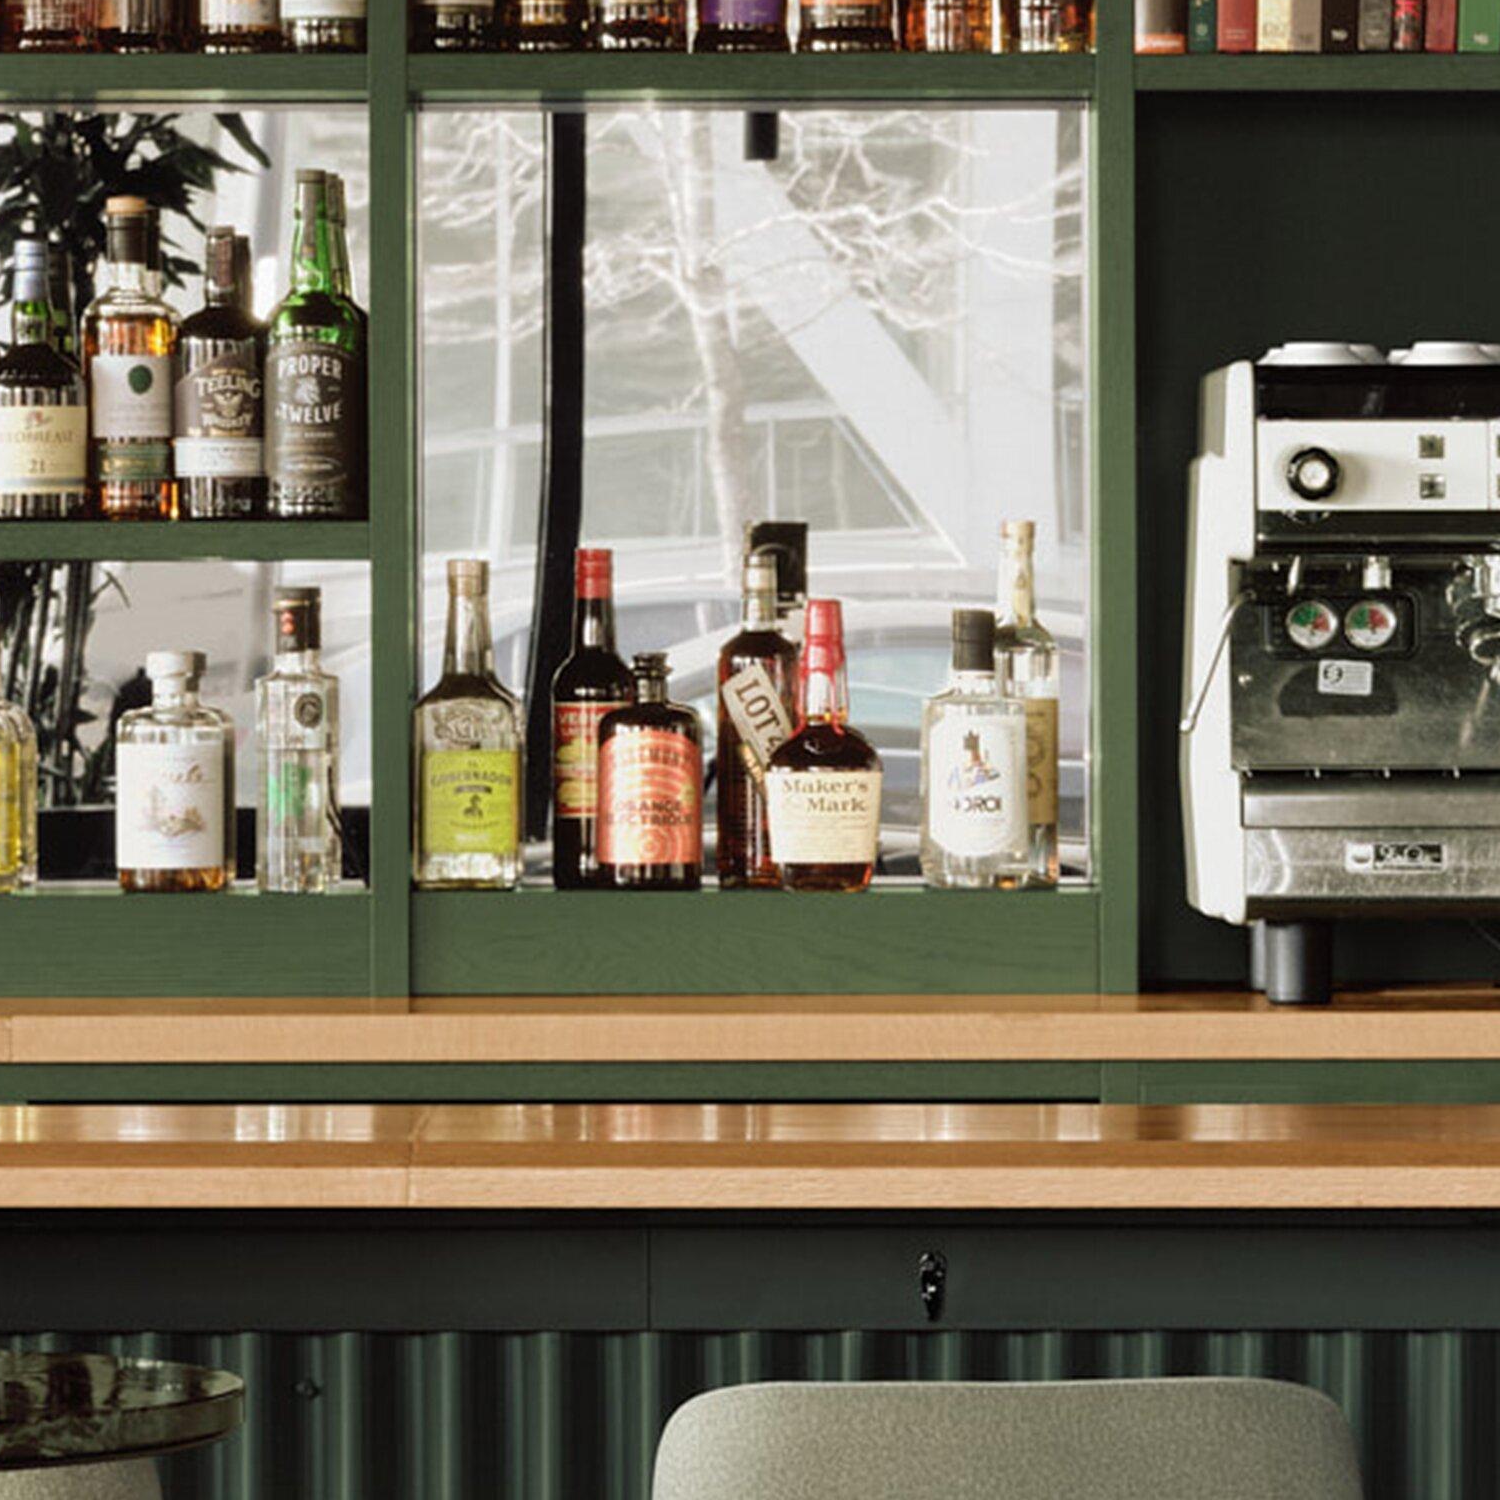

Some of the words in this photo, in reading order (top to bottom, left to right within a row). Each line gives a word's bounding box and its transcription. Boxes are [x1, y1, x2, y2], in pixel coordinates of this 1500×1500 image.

[277, 354, 343, 379] PROPER
[194, 375, 262, 398] TEELING
[278, 401, 342, 425] TWELVE
[28, 460, 46, 474] 21
[735, 679, 781, 733] LOT
[782, 779, 869, 794] Maker's
